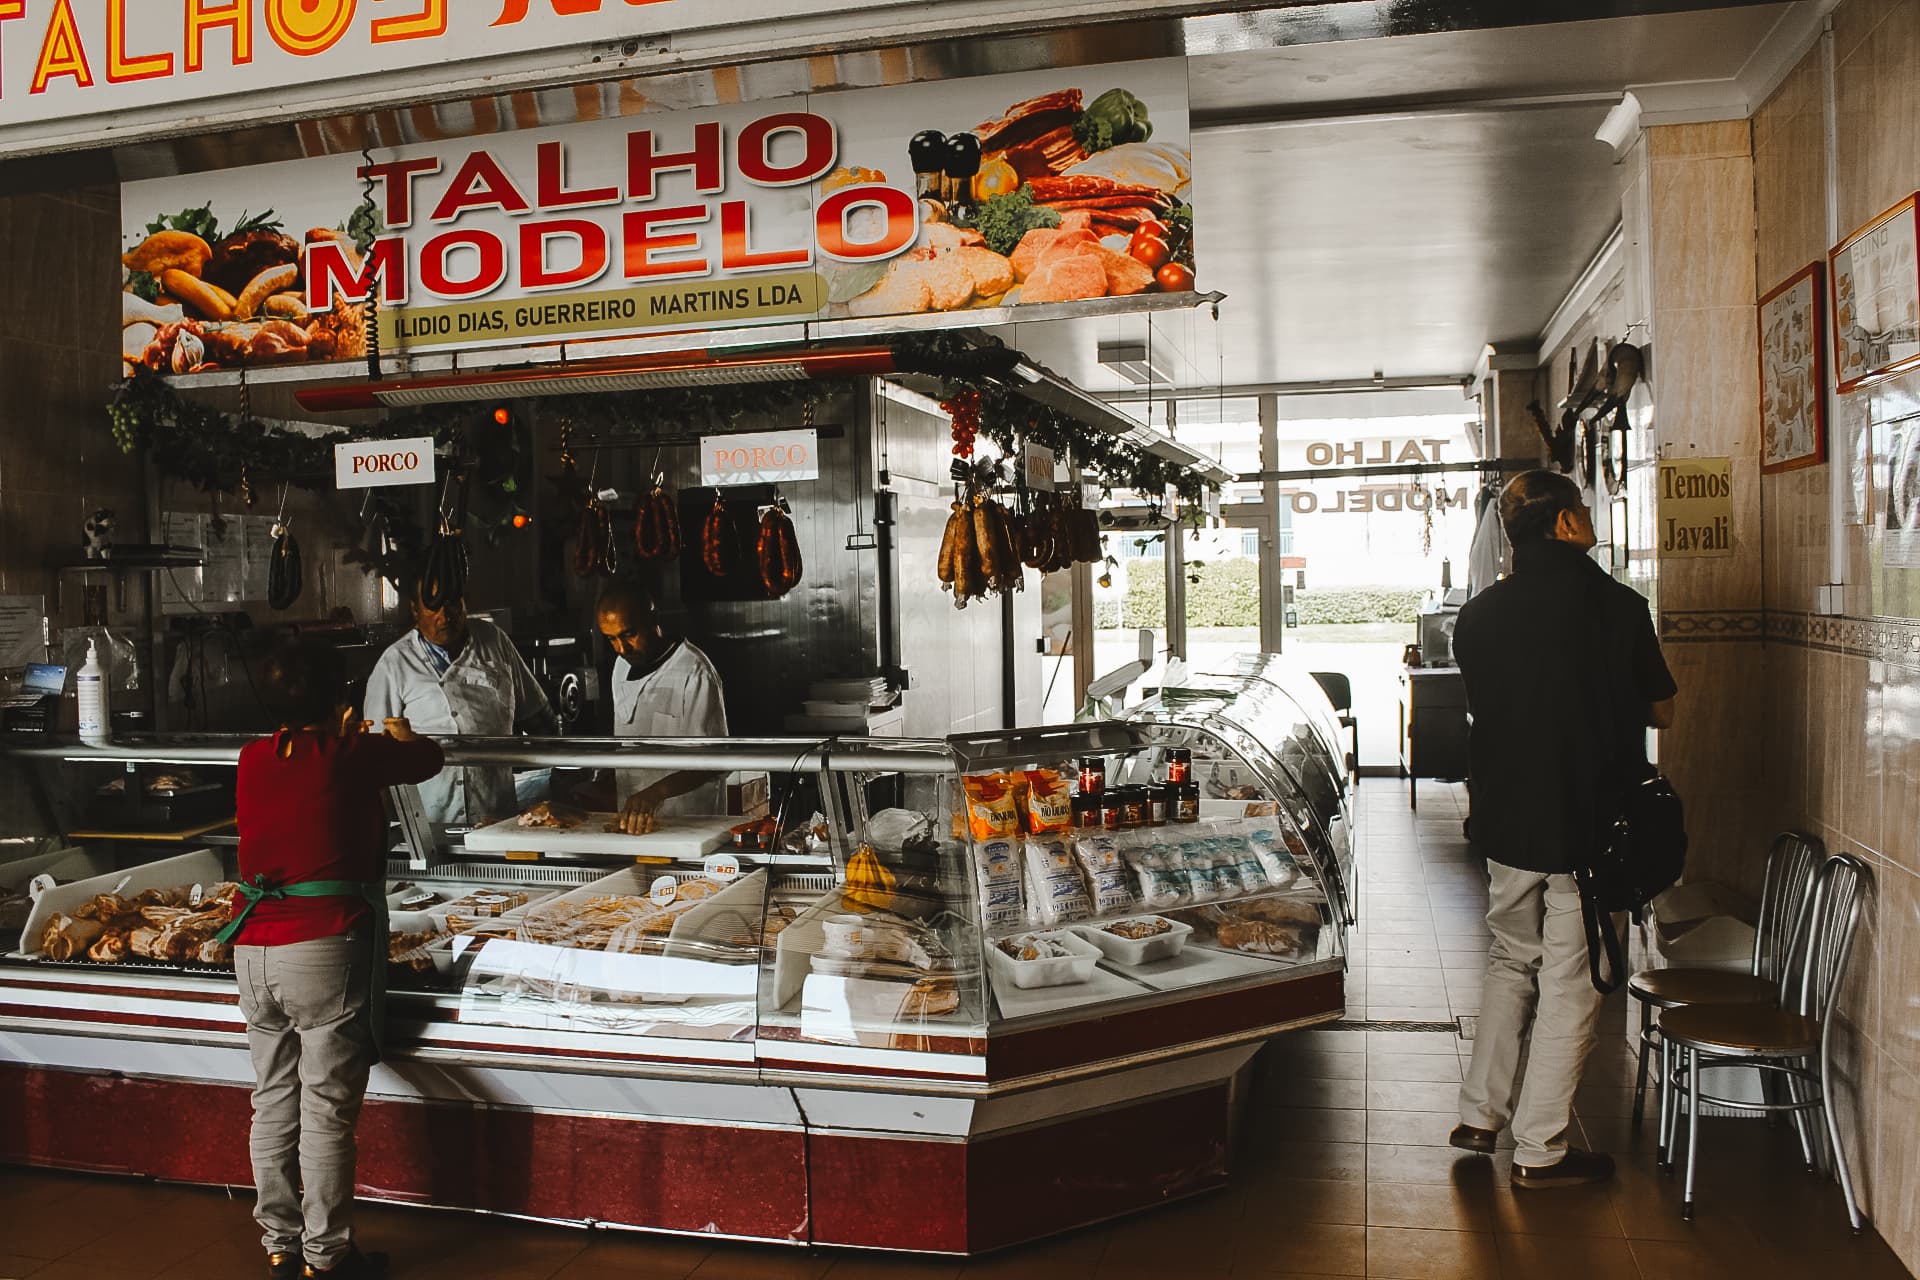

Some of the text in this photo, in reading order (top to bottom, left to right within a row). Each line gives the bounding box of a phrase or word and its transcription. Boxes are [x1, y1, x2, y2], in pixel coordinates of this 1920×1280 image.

[356, 111, 835, 227] TALHO
[307, 184, 916, 311] MODELO
[458, 309, 509, 333] DIAS,
[515, 298, 636, 328] GUERREIRO
[650, 288, 750, 316] MARTINS
[757, 283, 803, 308] LDA
[352, 451, 419, 474] PORCO
[713, 444, 807, 472] PORCO
[1660, 466, 1730, 500] Temos
[1663, 515, 1729, 552] Javali
